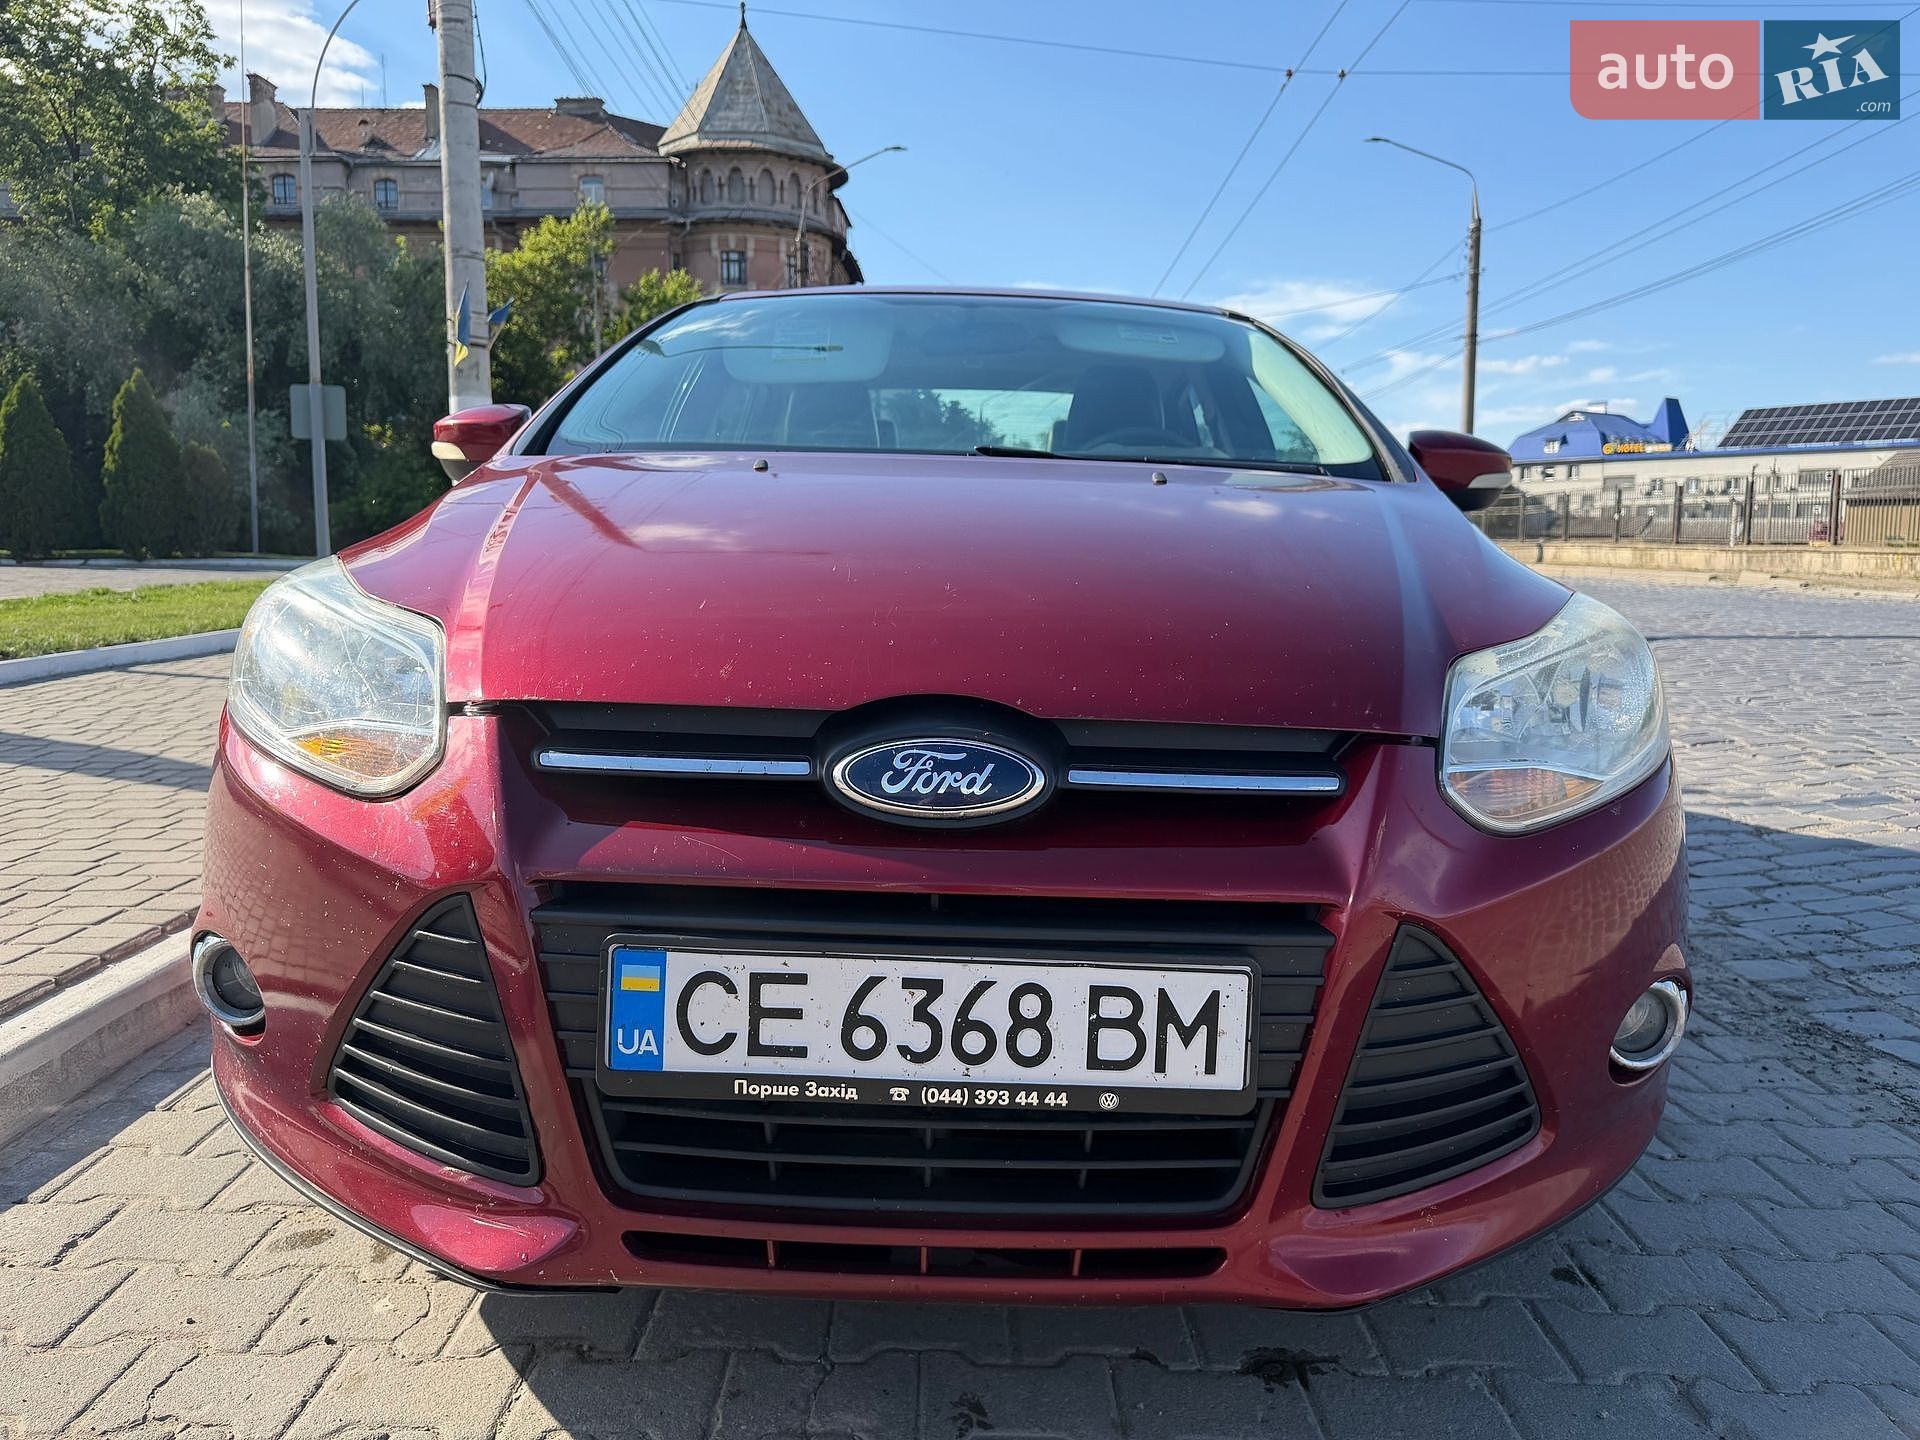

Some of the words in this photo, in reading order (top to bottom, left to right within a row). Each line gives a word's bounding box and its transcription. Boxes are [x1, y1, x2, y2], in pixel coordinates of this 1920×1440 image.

[881, 749, 995, 796] Ford
[676, 970, 808, 1058] CE
[840, 975, 1053, 1068] 6368
[1086, 984, 1221, 1075] BM
[617, 1028, 659, 1056] UA
[734, 1079, 799, 1099] Порше
[804, 1081, 858, 1100] Захід
[921, 1086, 969, 1106] (044)
[974, 1089, 1010, 1106] 393
[1015, 1090, 1039, 1107] 44
[1044, 1091, 1069, 1108] 44
